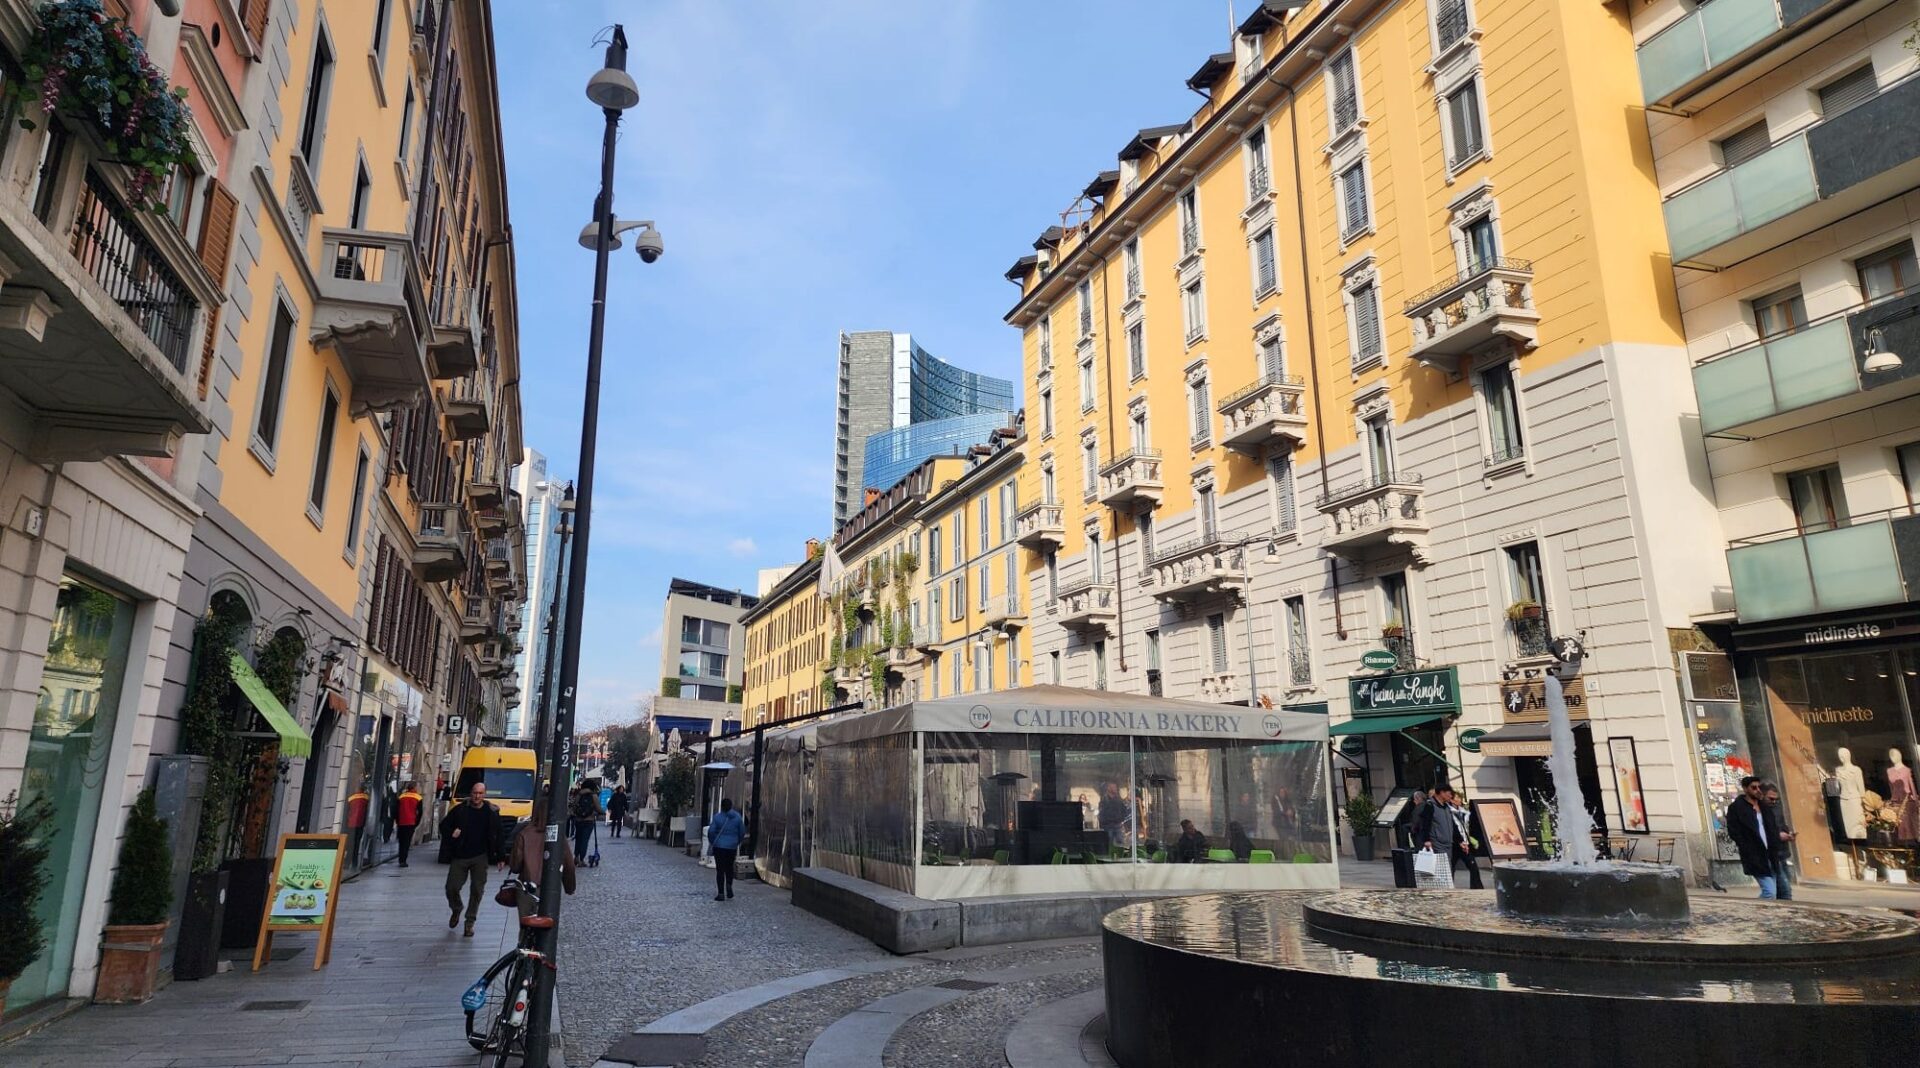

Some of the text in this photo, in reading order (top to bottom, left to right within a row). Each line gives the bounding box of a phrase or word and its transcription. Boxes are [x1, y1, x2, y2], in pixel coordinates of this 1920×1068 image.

[1804, 623, 1881, 644] midinette
[1403, 674, 1447, 705] Langhe
[972, 712, 989, 721] TEN
[1013, 708, 1241, 733] CALIFORNIA BAKERY
[1801, 705, 1874, 724] midinette
[448, 716, 462, 730] G
[1265, 721, 1280, 730] TEN
[291, 871, 318, 880] Fresh
